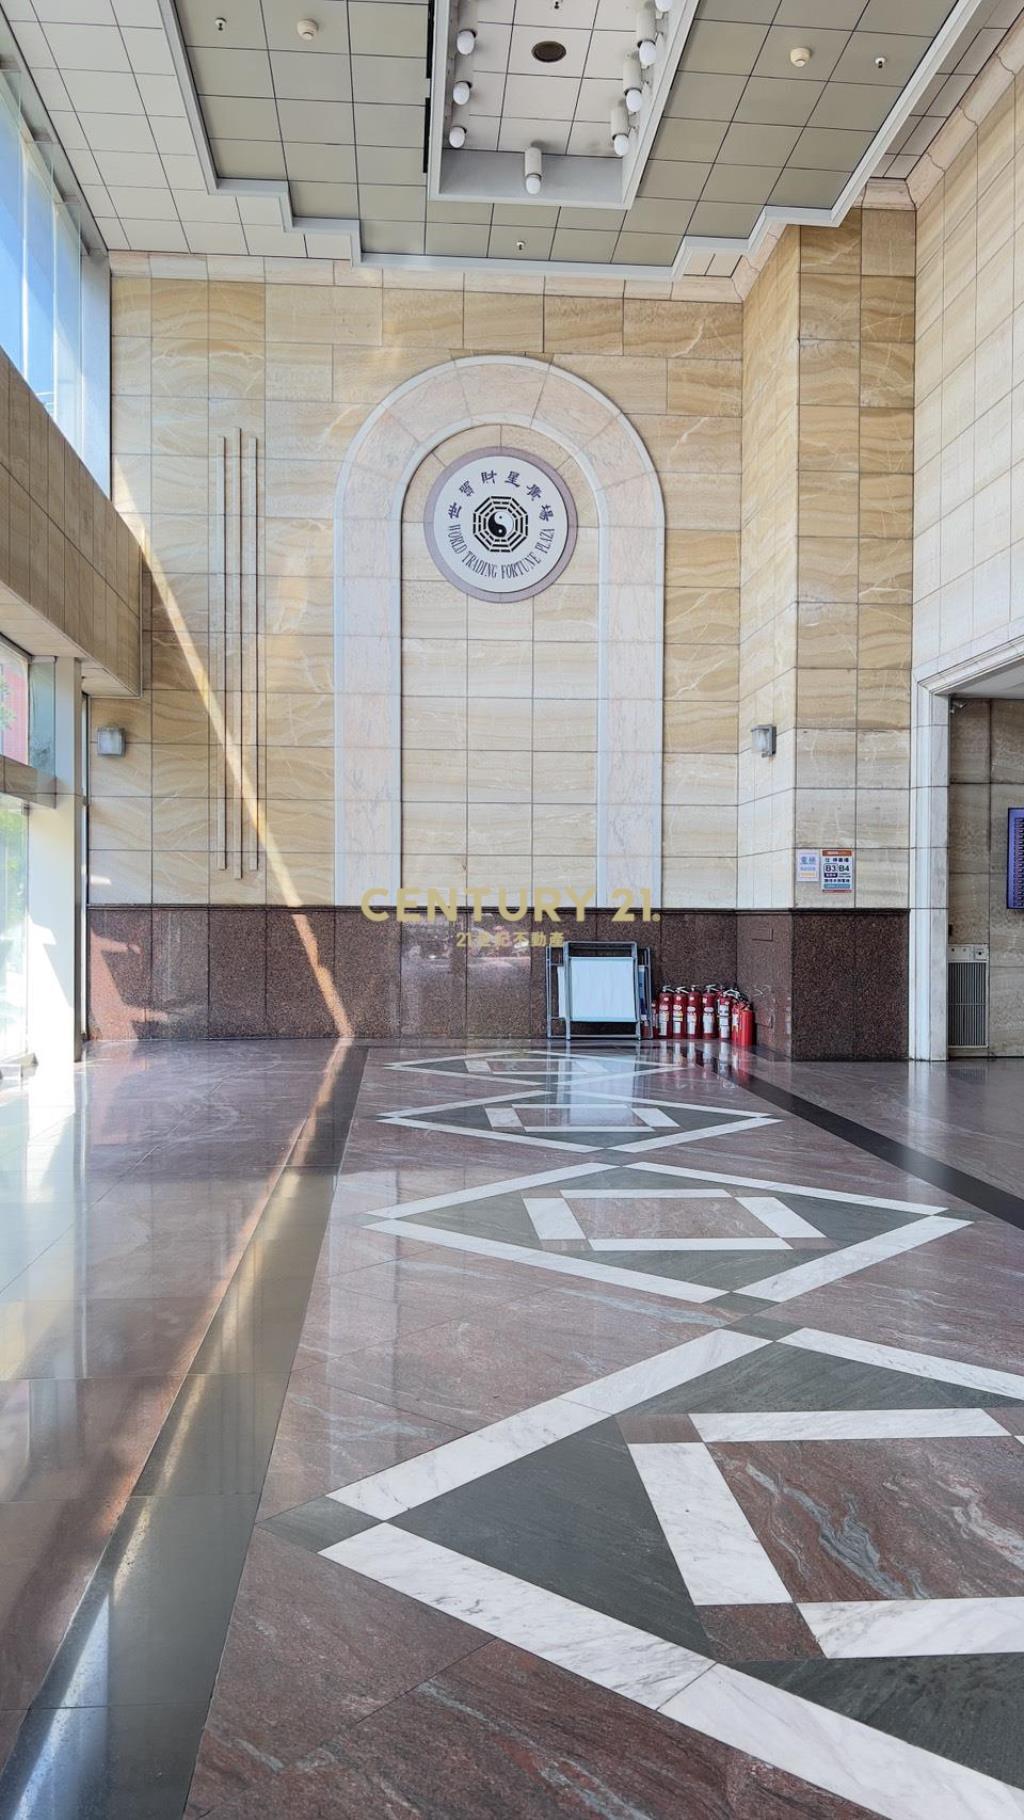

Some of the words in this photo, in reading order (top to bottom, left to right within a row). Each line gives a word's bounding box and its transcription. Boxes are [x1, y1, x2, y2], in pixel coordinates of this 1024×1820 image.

[448, 524, 467, 555] WORLD
[461, 550, 499, 578] TRADING
[500, 551, 542, 580] FORTUNE
[535, 528, 555, 554] PLAZA
